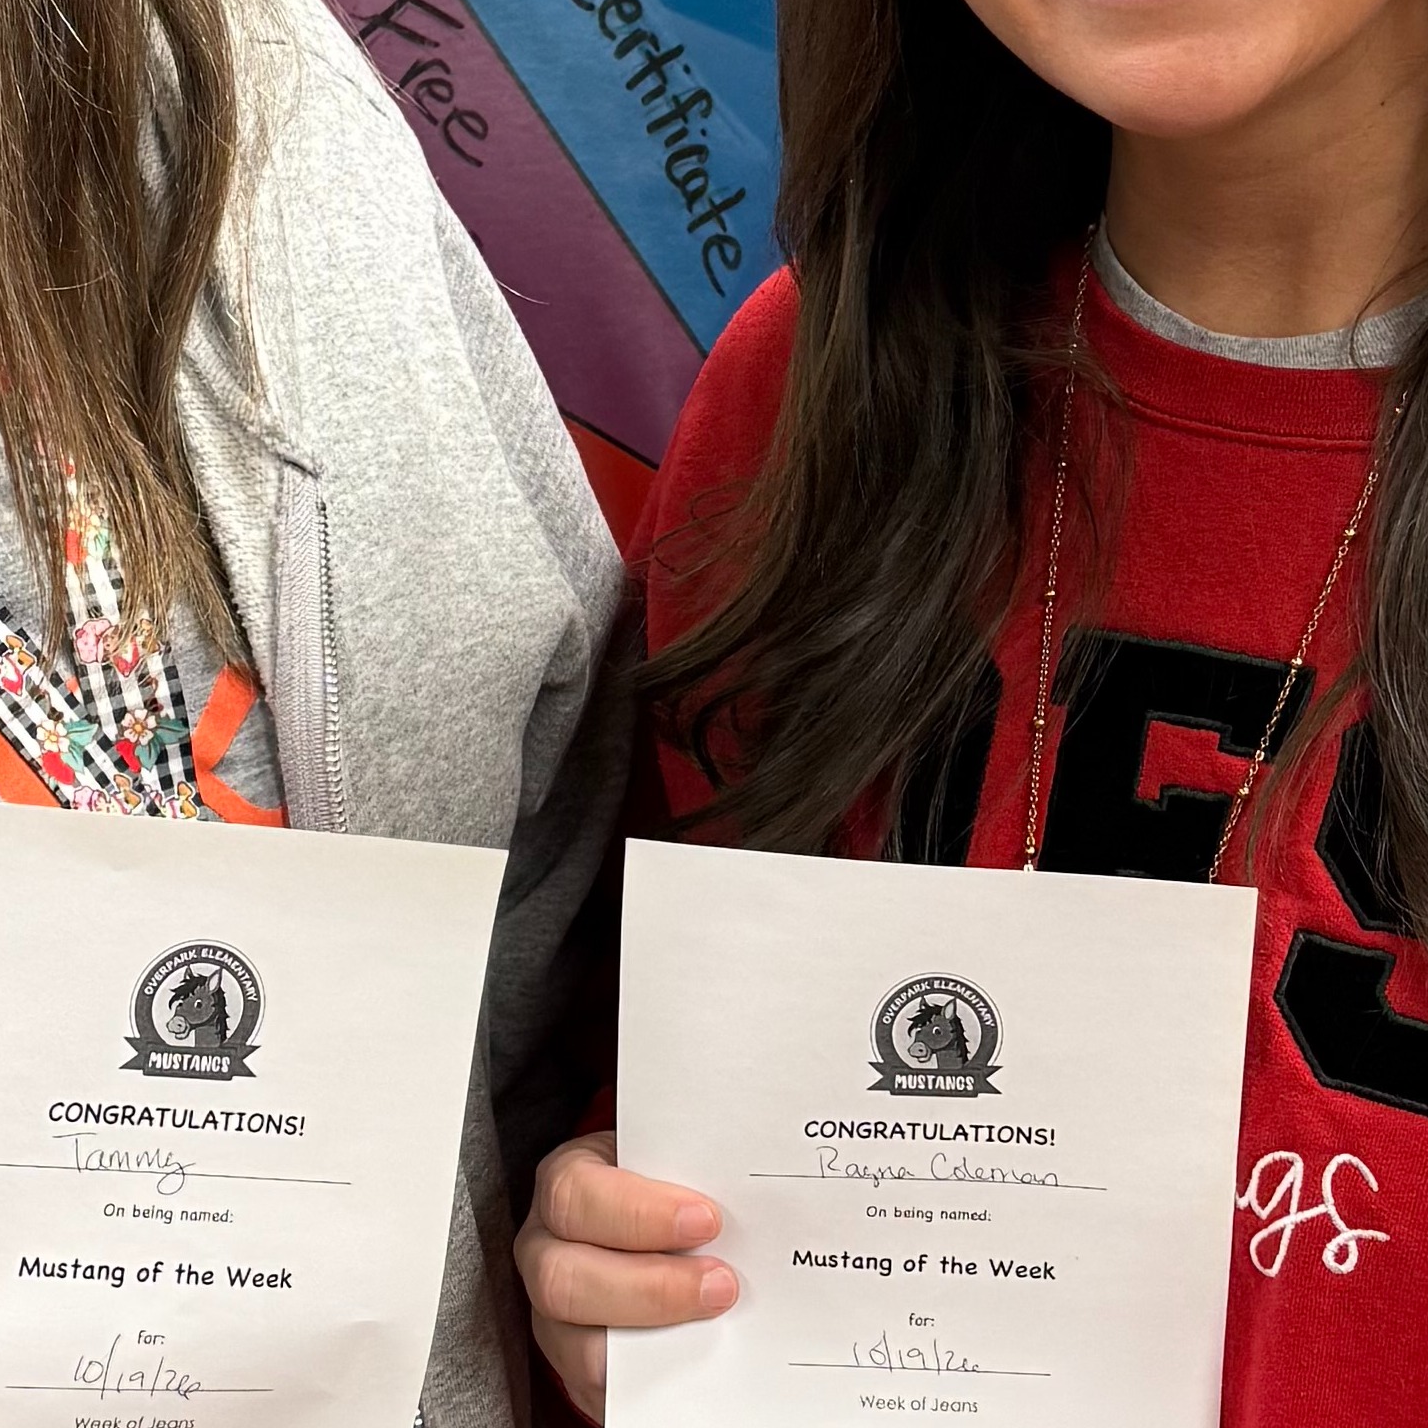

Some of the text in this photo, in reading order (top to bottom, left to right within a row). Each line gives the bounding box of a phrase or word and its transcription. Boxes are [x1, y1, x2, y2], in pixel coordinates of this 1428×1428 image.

[143, 947, 259, 1002] OVERPARK ELEMENTARY
[882, 979, 995, 1027] OVERPARK ELEMENTARY
[148, 1051, 231, 1073] MUSTANGS
[894, 1074, 975, 1091] MUSTANGS
[48, 1101, 307, 1137] CONGRATULATIONS!
[803, 1120, 1057, 1146] CONGRATULATIONS!
[52, 1132, 197, 1195] Tammy
[930, 1152, 1060, 1187] Coleman
[103, 1203, 234, 1224] On being named:
[865, 1205, 992, 1223] On being named:
[18, 1256, 293, 1290] Mustang of the Week
[792, 1249, 1057, 1281] Mustang of the Week
[908, 1312, 935, 1327] for:
[137, 1330, 166, 1346] for:
[860, 1395, 979, 1413] Week of Jeans
